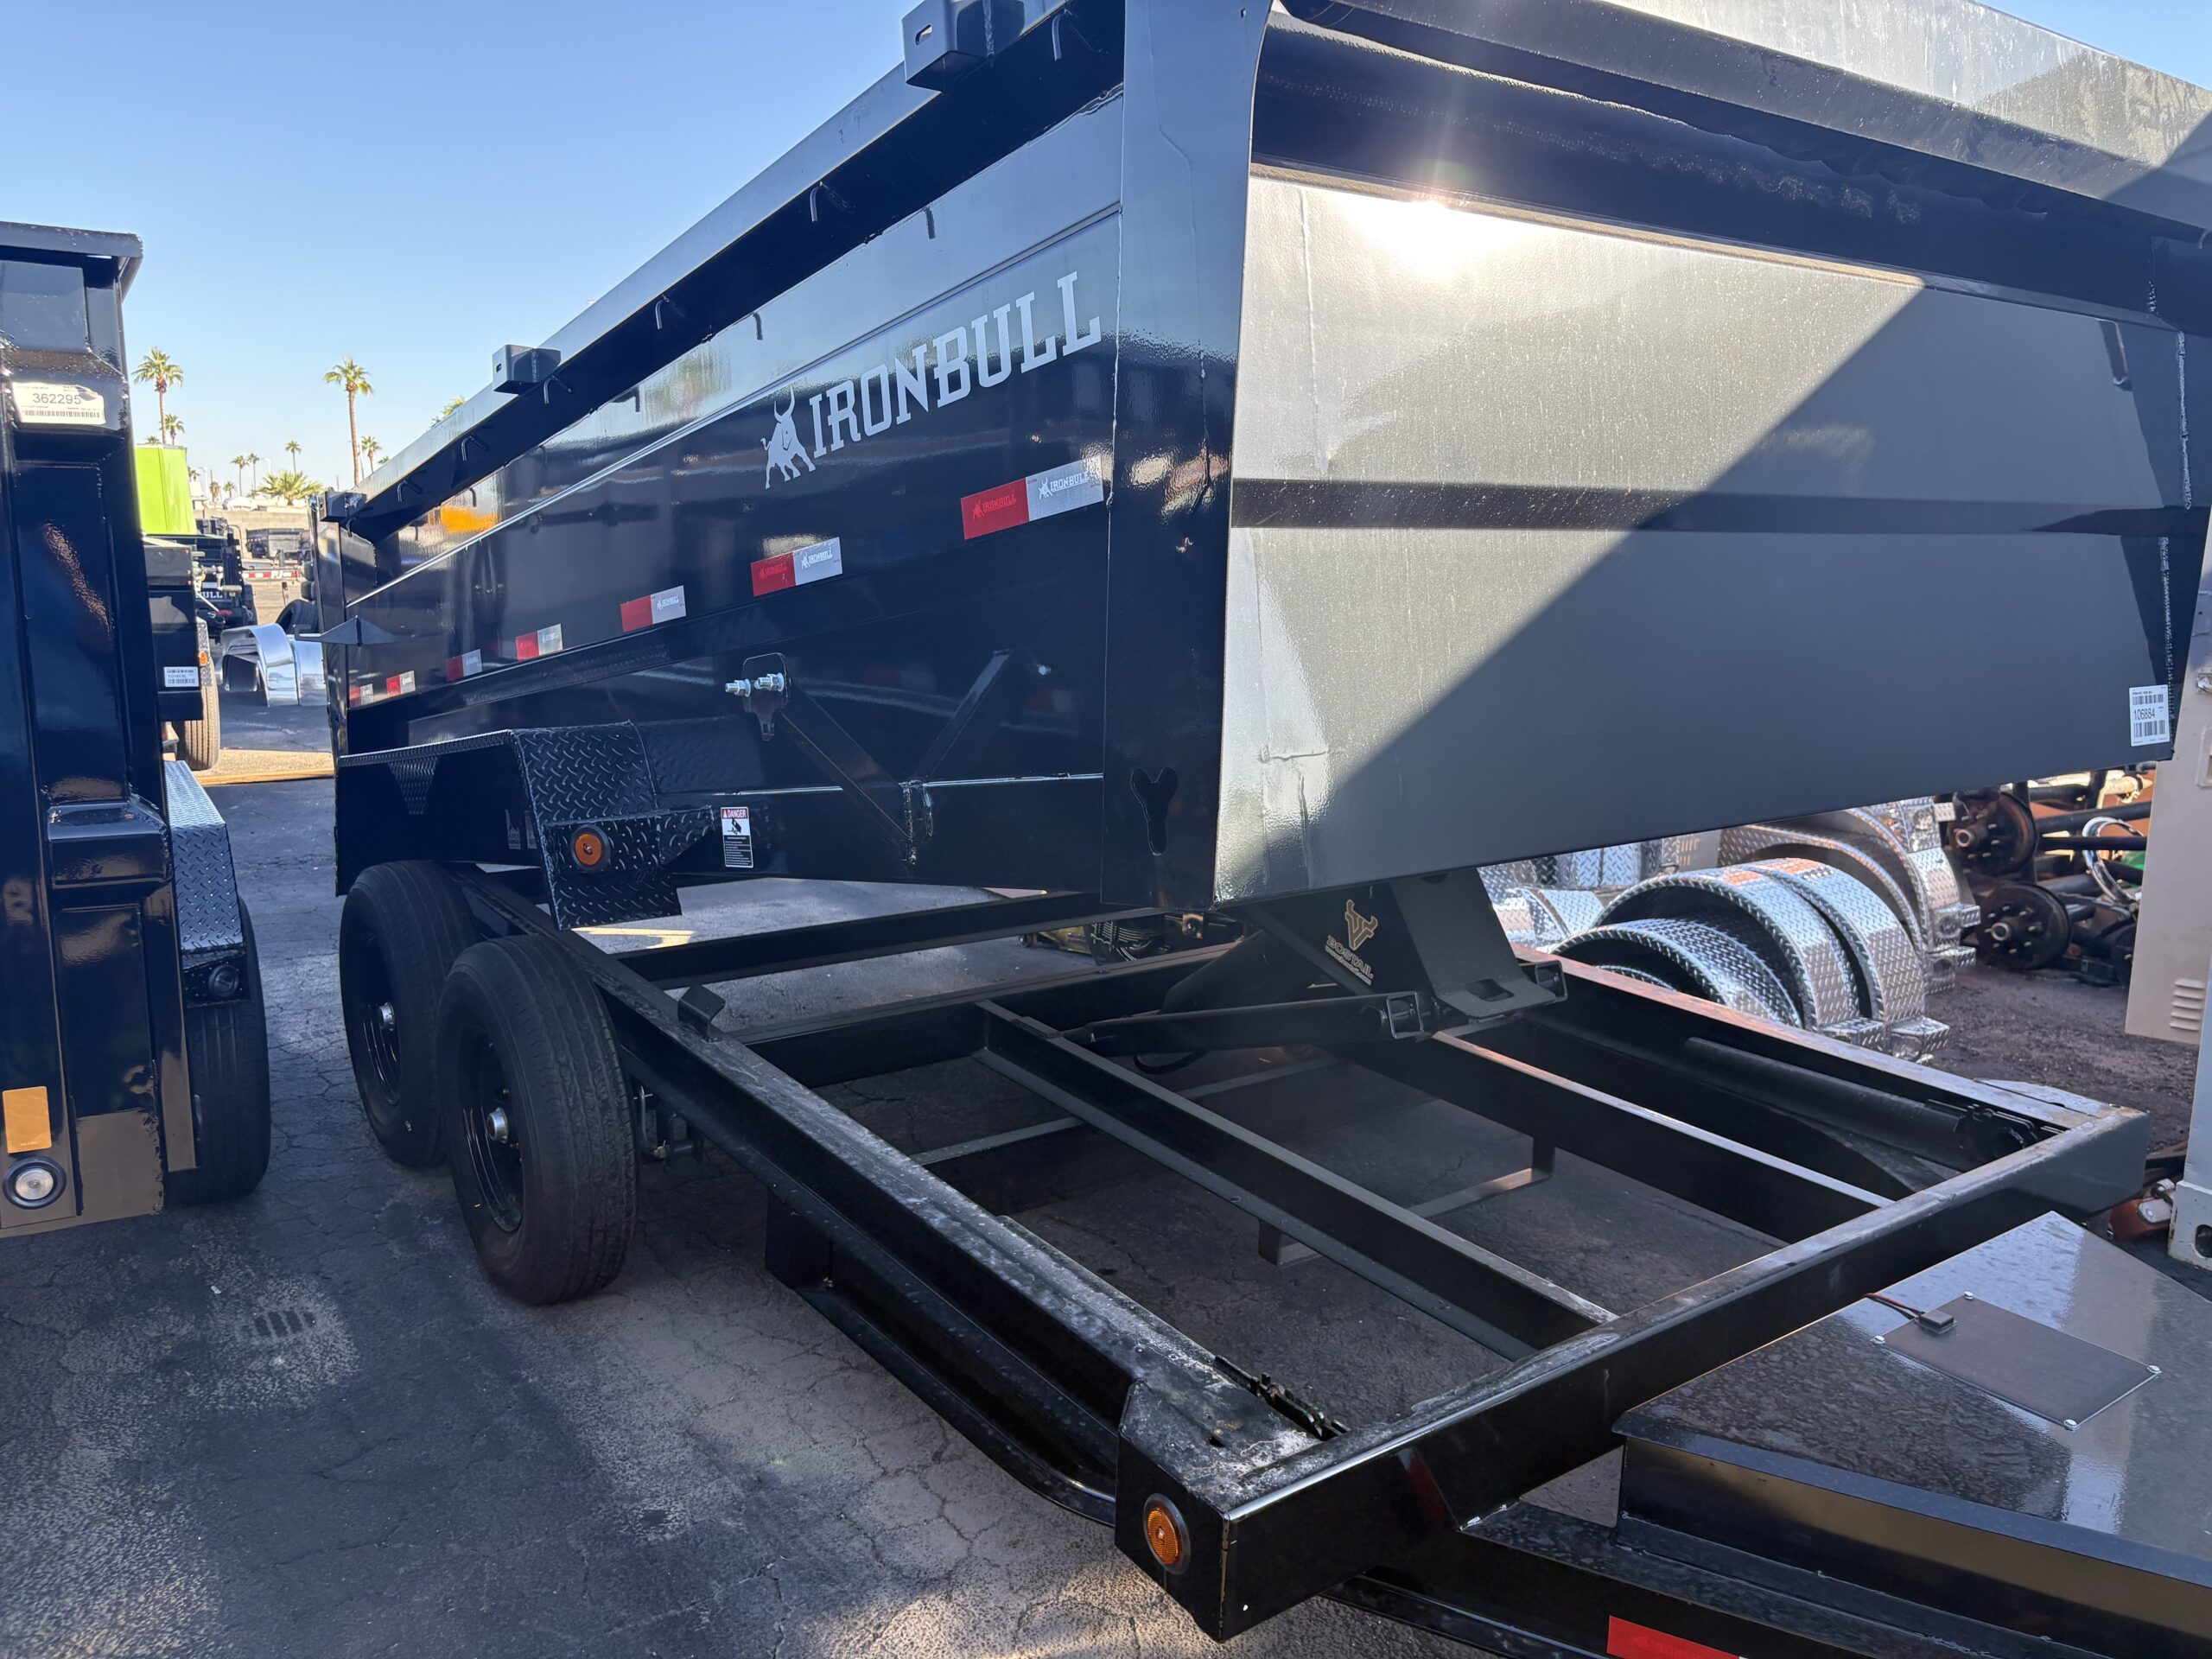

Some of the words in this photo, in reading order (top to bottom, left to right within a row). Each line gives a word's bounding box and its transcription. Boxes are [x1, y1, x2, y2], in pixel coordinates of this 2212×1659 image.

[809, 270, 1102, 459] IRONBULL
[33, 392, 81, 404] 362295
[1050, 471, 1089, 493] IRONBULL
[2133, 707, 2155, 720] 106884
[727, 809, 747, 818] DANGER
[1326, 935, 1374, 979] BOSTAIL
